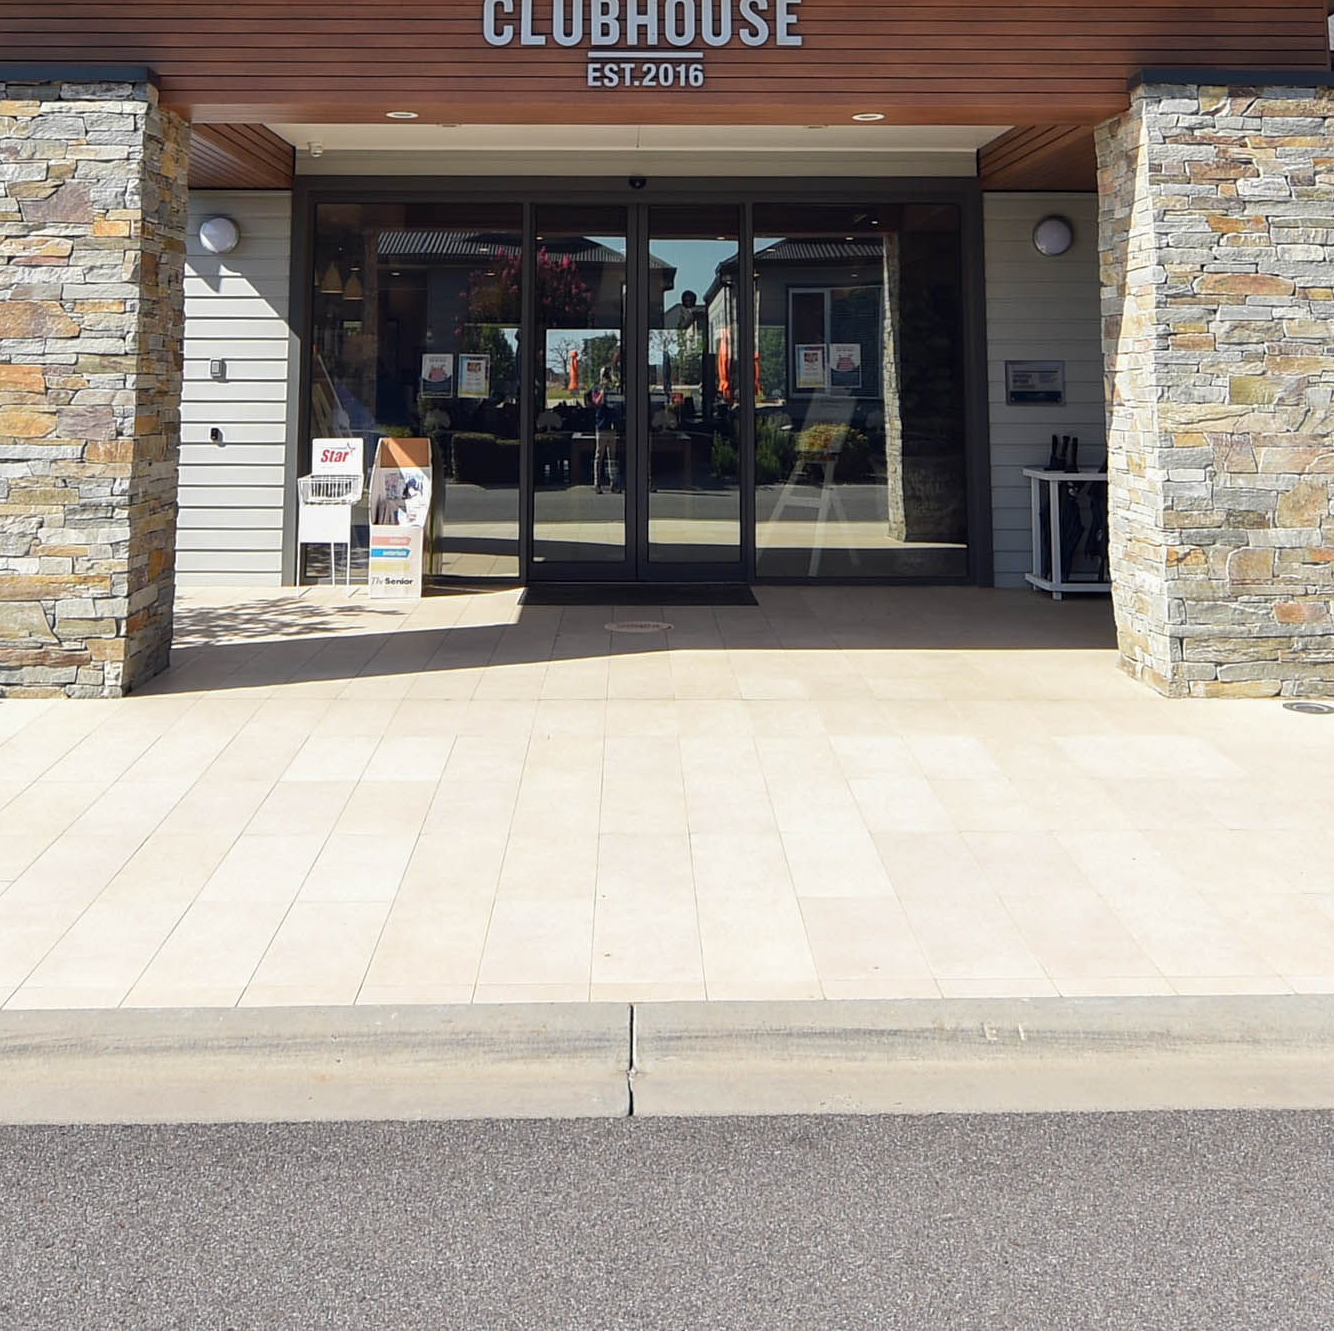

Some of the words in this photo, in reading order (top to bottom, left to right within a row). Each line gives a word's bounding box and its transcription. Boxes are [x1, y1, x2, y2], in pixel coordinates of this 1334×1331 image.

[586, 62, 705, 88] EST.2016
[320, 449, 350, 463] Star
[385, 577, 414, 585] Senior
